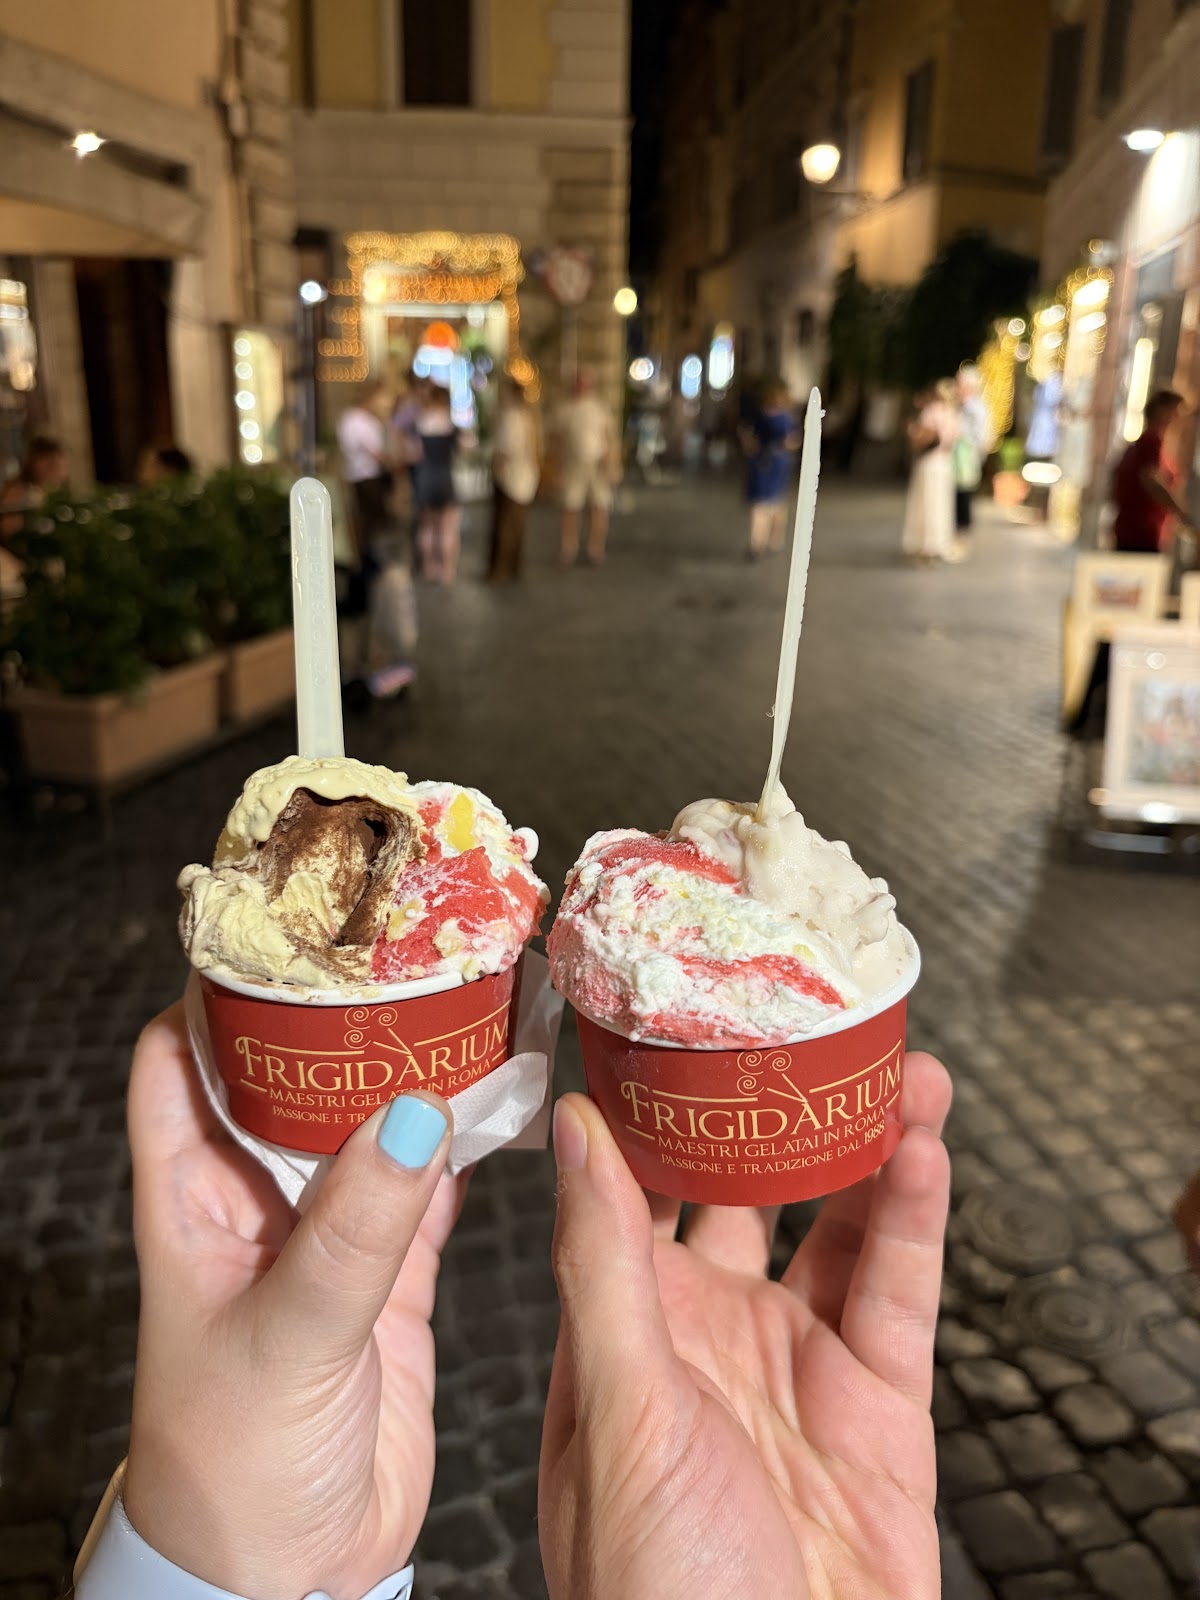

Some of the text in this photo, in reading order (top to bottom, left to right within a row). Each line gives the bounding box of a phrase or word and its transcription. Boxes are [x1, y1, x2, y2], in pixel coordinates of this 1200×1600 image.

[235, 1014, 508, 1091] FRIGIDARIUM
[270, 1087, 346, 1107] MAESTRI
[350, 1085, 423, 1107] GELA
[427, 1079, 444, 1093] IN
[448, 1058, 490, 1088] ROMA
[620, 1053, 900, 1140] FRIGIDARIUM
[273, 1105, 330, 1123] PASSIONE
[335, 1113, 343, 1123] E
[658, 1105, 885, 1157] MAESTRI GELATAI IN ROMA
[661, 1120, 885, 1174] PASSIONE E TRADIZIONE DAL 1988
